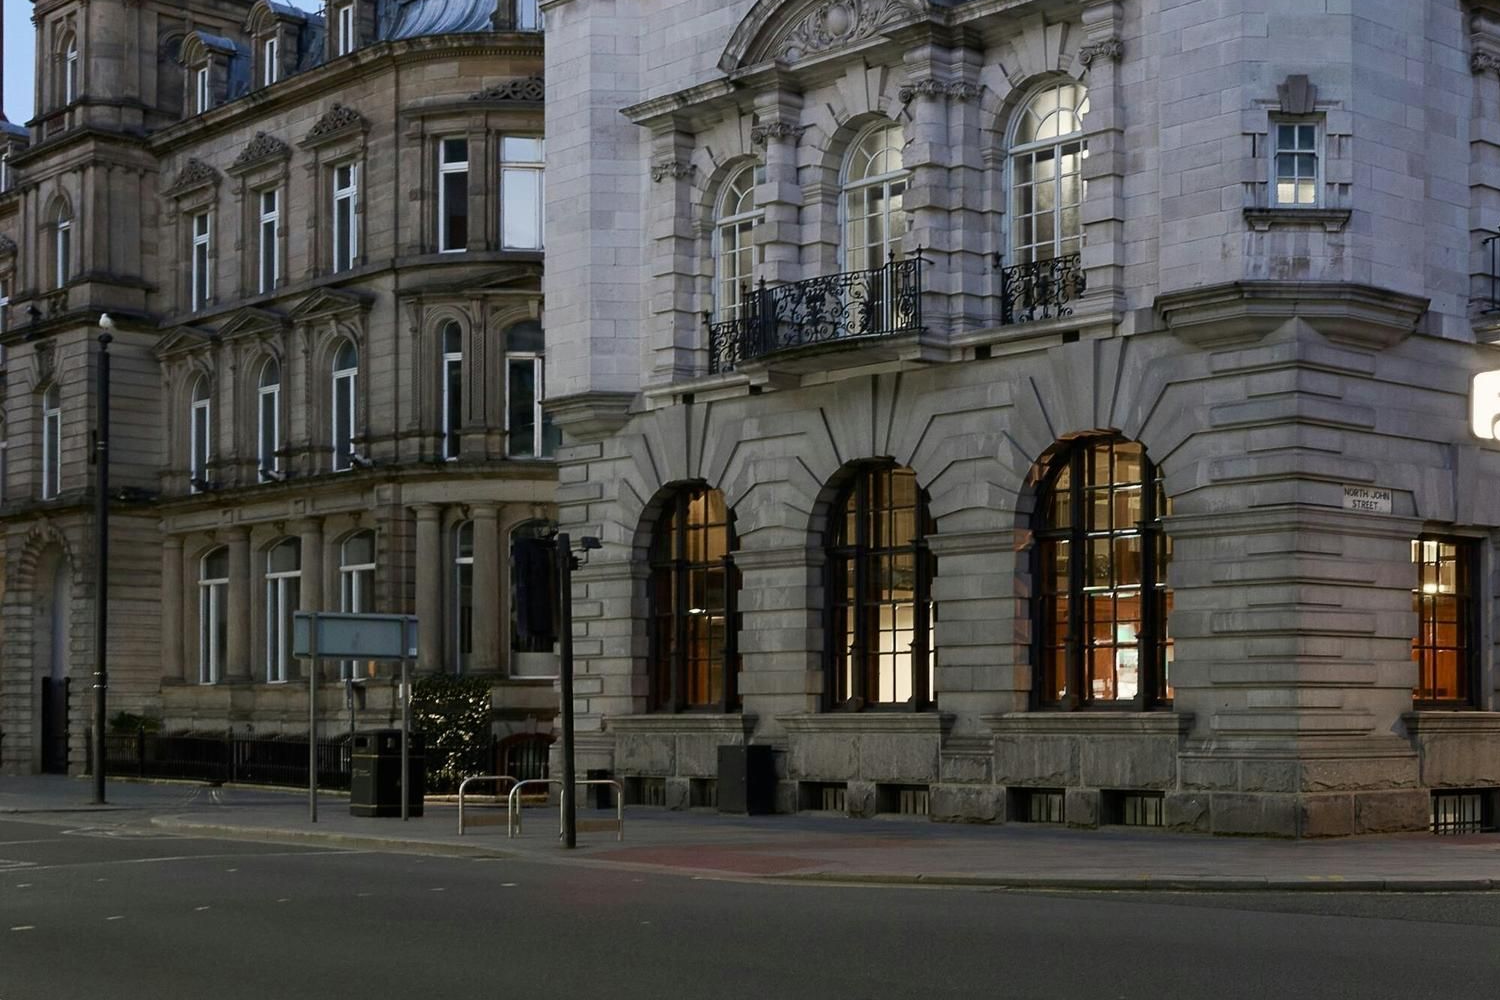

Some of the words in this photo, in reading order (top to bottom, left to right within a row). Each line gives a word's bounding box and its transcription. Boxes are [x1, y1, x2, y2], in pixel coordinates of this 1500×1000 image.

[1344, 487, 1369, 498] NORTH
[1371, 491, 1390, 501] JOHN
[1352, 499, 1378, 510] STREET
